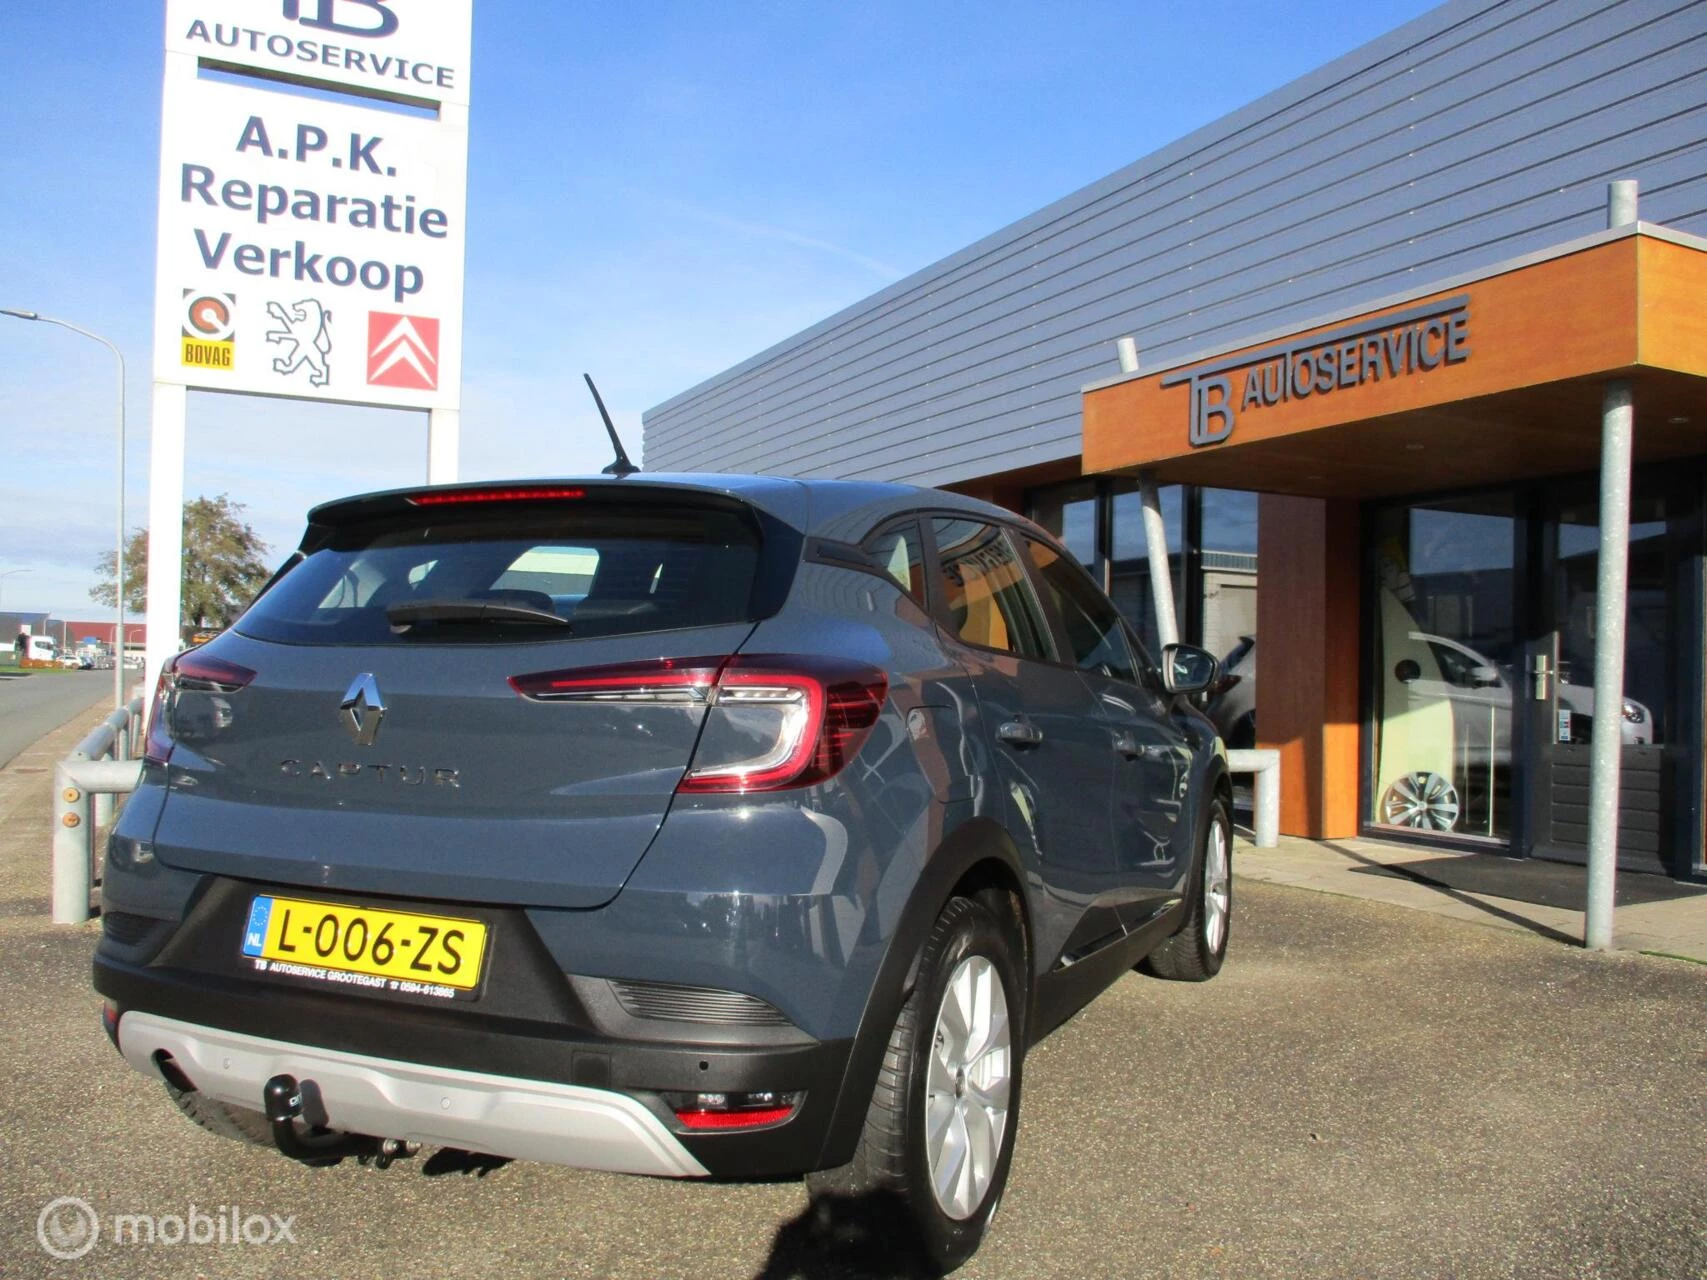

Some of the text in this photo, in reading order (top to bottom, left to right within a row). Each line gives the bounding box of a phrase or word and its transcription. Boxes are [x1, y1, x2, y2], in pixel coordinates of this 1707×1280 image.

[186, 19, 455, 89] AUTOSERVICE
[236, 115, 397, 177] A.P.K.
[181, 163, 448, 239] Reparatie
[193, 228, 424, 302] Verkoop
[185, 343, 231, 366] BOVAG
[1241, 306, 1472, 412] AUTOSERVICE
[280, 759, 461, 788] CAPTUR
[247, 932, 262, 948] NL
[278, 908, 466, 976] L-006-ZS
[254, 959, 267, 971] TB
[269, 961, 326, 980] AUTOSERVICE
[327, 970, 387, 988] GROOTEGAST
